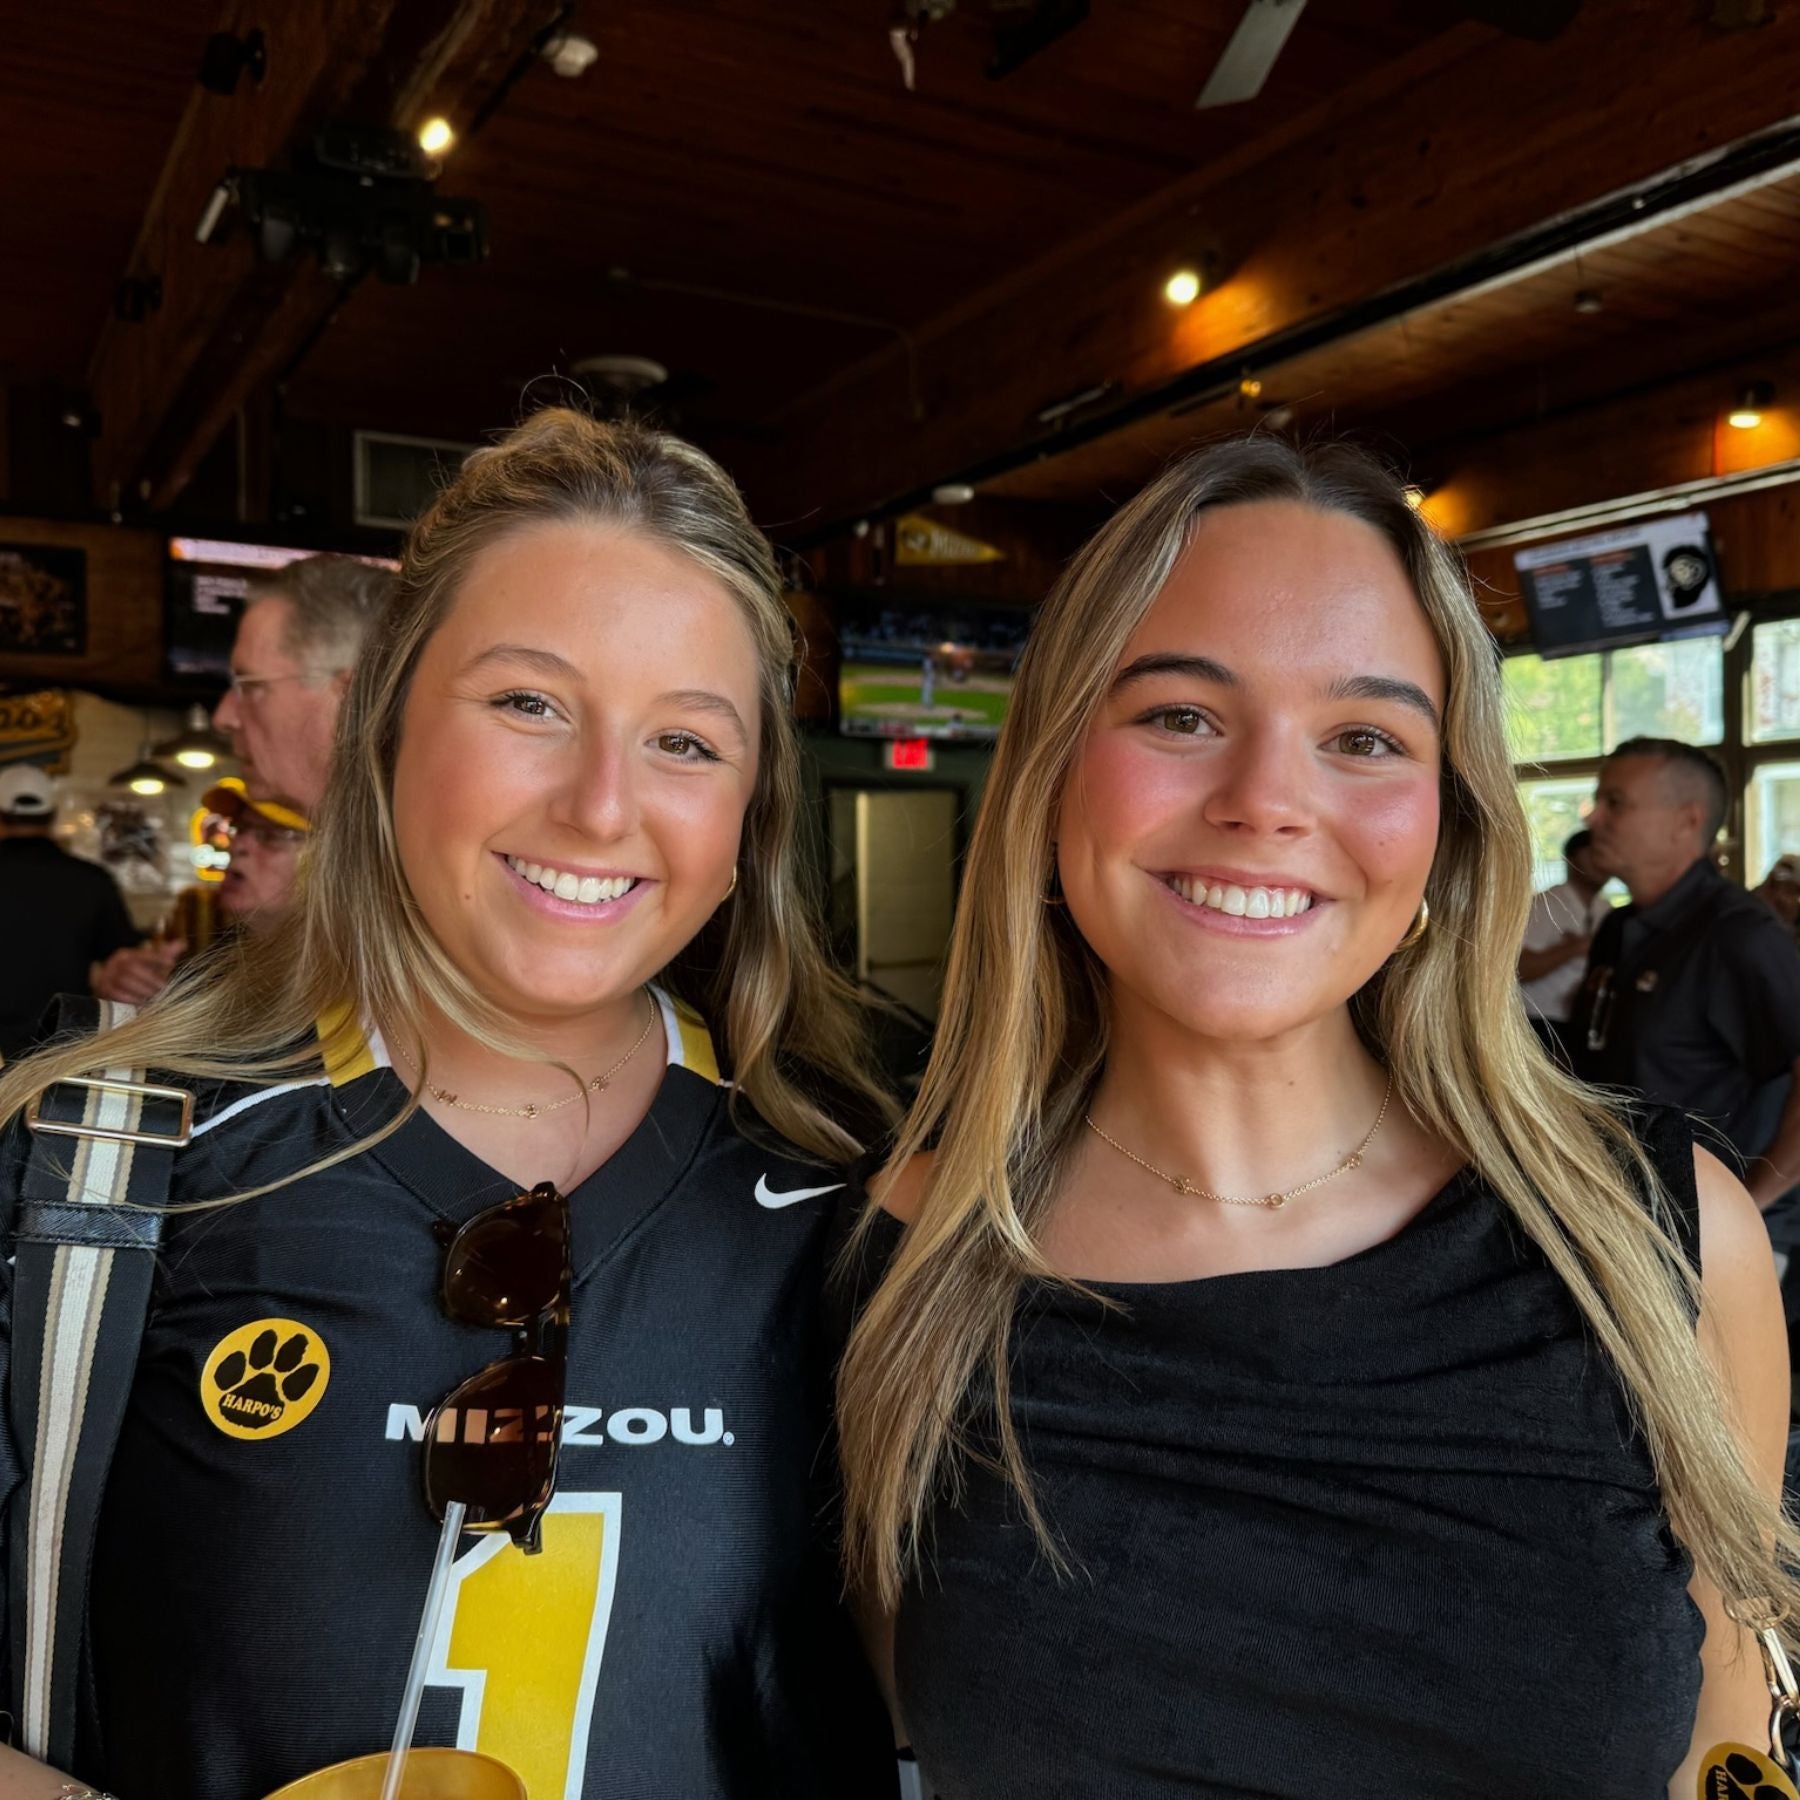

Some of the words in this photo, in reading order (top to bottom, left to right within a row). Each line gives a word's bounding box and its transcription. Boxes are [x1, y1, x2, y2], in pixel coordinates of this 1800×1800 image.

[221, 1393, 283, 1420] HARPO'S
[385, 1403, 724, 1445] MIZZOU
[420, 1492, 622, 1800] 1
